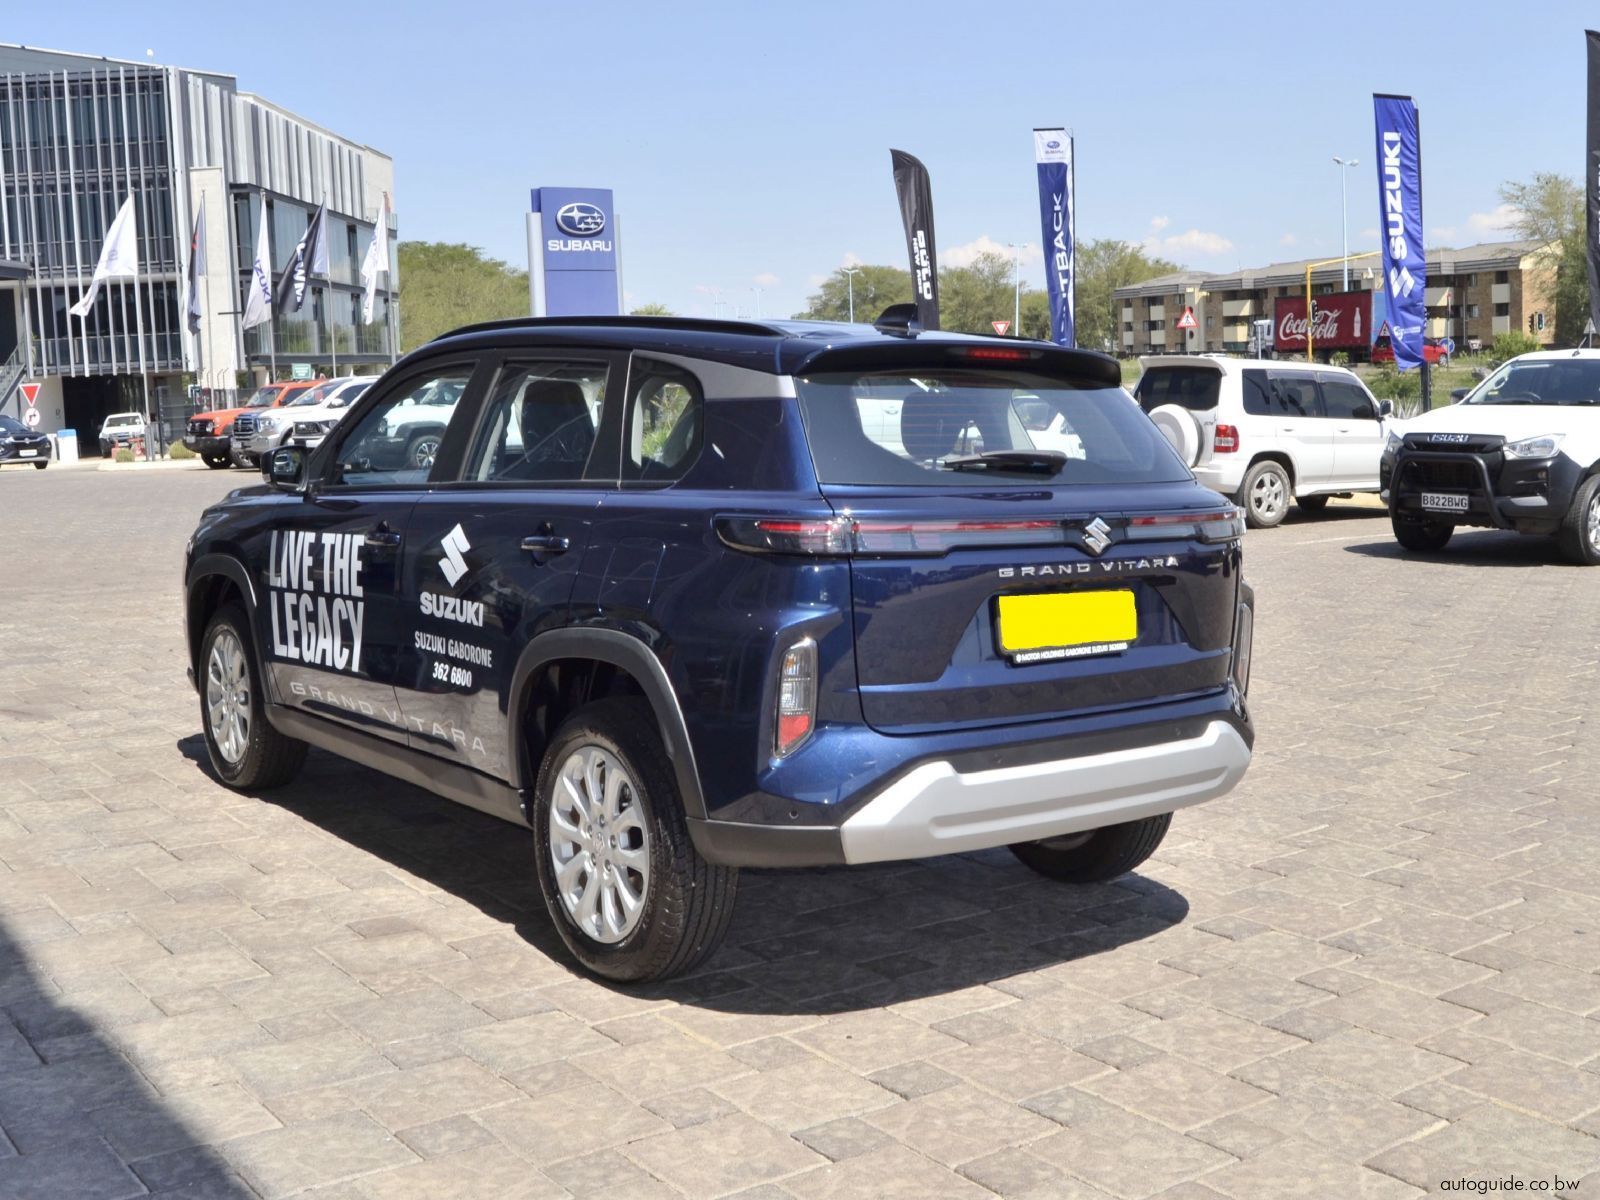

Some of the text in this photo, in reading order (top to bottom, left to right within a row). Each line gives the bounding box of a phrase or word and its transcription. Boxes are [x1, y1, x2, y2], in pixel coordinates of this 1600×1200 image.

[1383, 131, 1408, 261] SUZUKI
[547, 239, 612, 252] SUBARU
[1053, 193, 1069, 341] TBACK
[1279, 309, 1342, 341] CocaCola
[1431, 434, 1469, 443] ISUZU
[1422, 495, 1468, 508] B822BWG
[269, 530, 365, 598] LIVE THE
[998, 556, 1179, 578] GRAND VITARA
[419, 591, 484, 627] SUZUKI
[270, 590, 365, 673] LEGACY
[414, 630, 493, 668] SUZUKI GABORONE
[432, 661, 472, 688] 362 6800
[290, 681, 487, 756] GRAND VITARA
